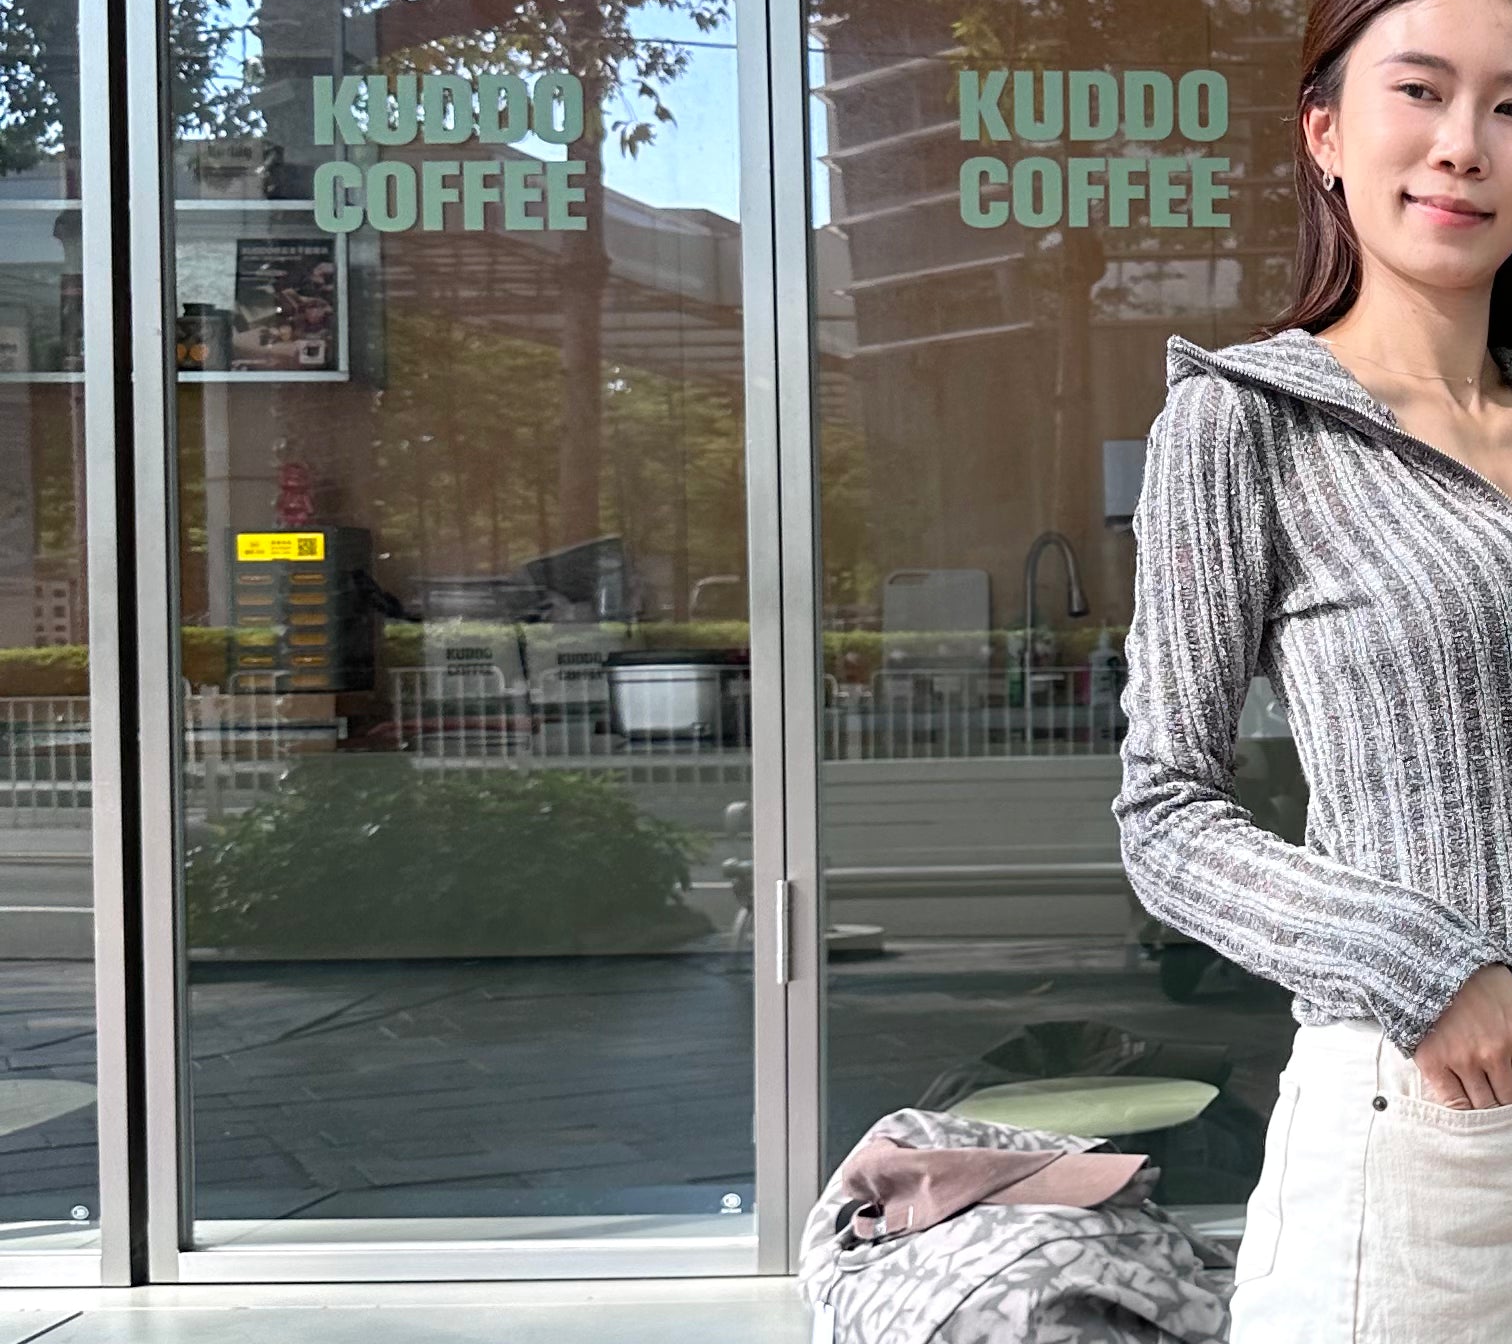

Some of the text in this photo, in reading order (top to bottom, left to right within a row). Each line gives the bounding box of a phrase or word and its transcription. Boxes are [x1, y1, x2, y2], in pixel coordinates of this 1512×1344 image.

[312, 73, 585, 146] KUDDO
[959, 69, 1230, 142] KUDDO
[312, 160, 588, 232] COFFEE
[959, 156, 1231, 228] COFFEE
